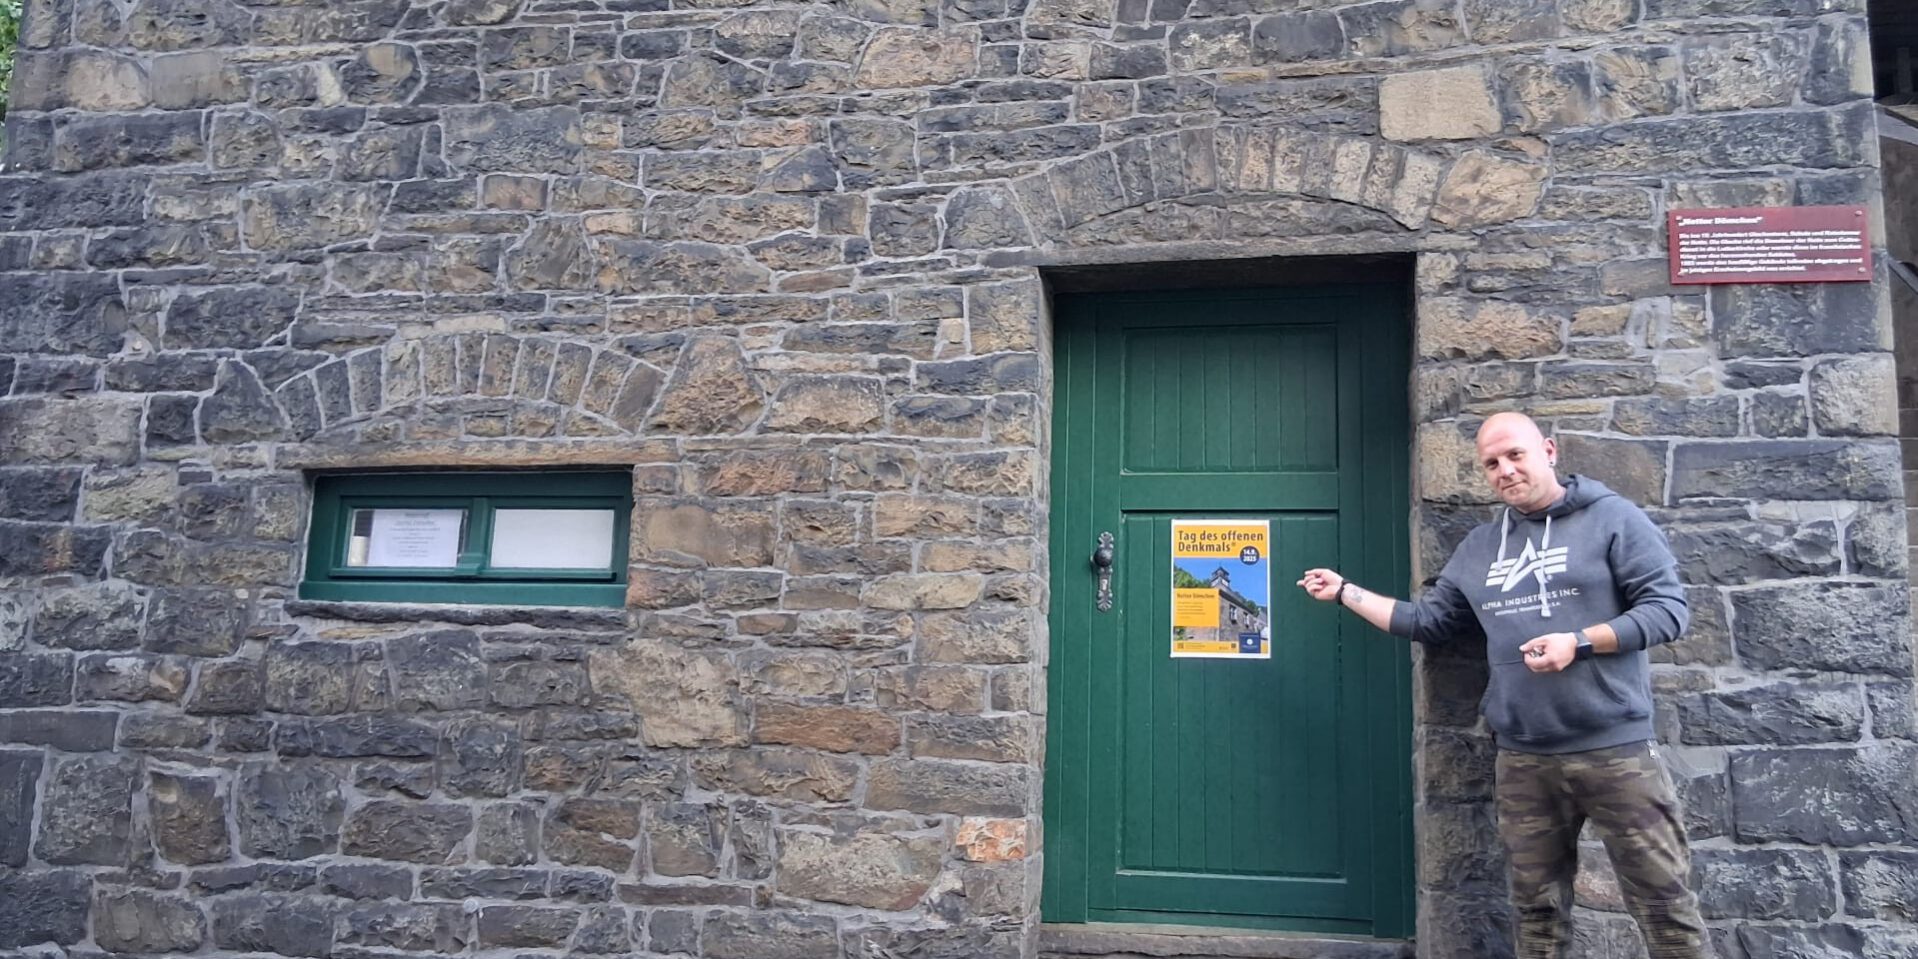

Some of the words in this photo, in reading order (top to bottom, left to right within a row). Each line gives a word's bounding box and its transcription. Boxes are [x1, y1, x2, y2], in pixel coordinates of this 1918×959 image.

[1178, 530, 1197, 543] Tag
[1200, 530, 1218, 541] des
[1221, 530, 1263, 541] offenen
